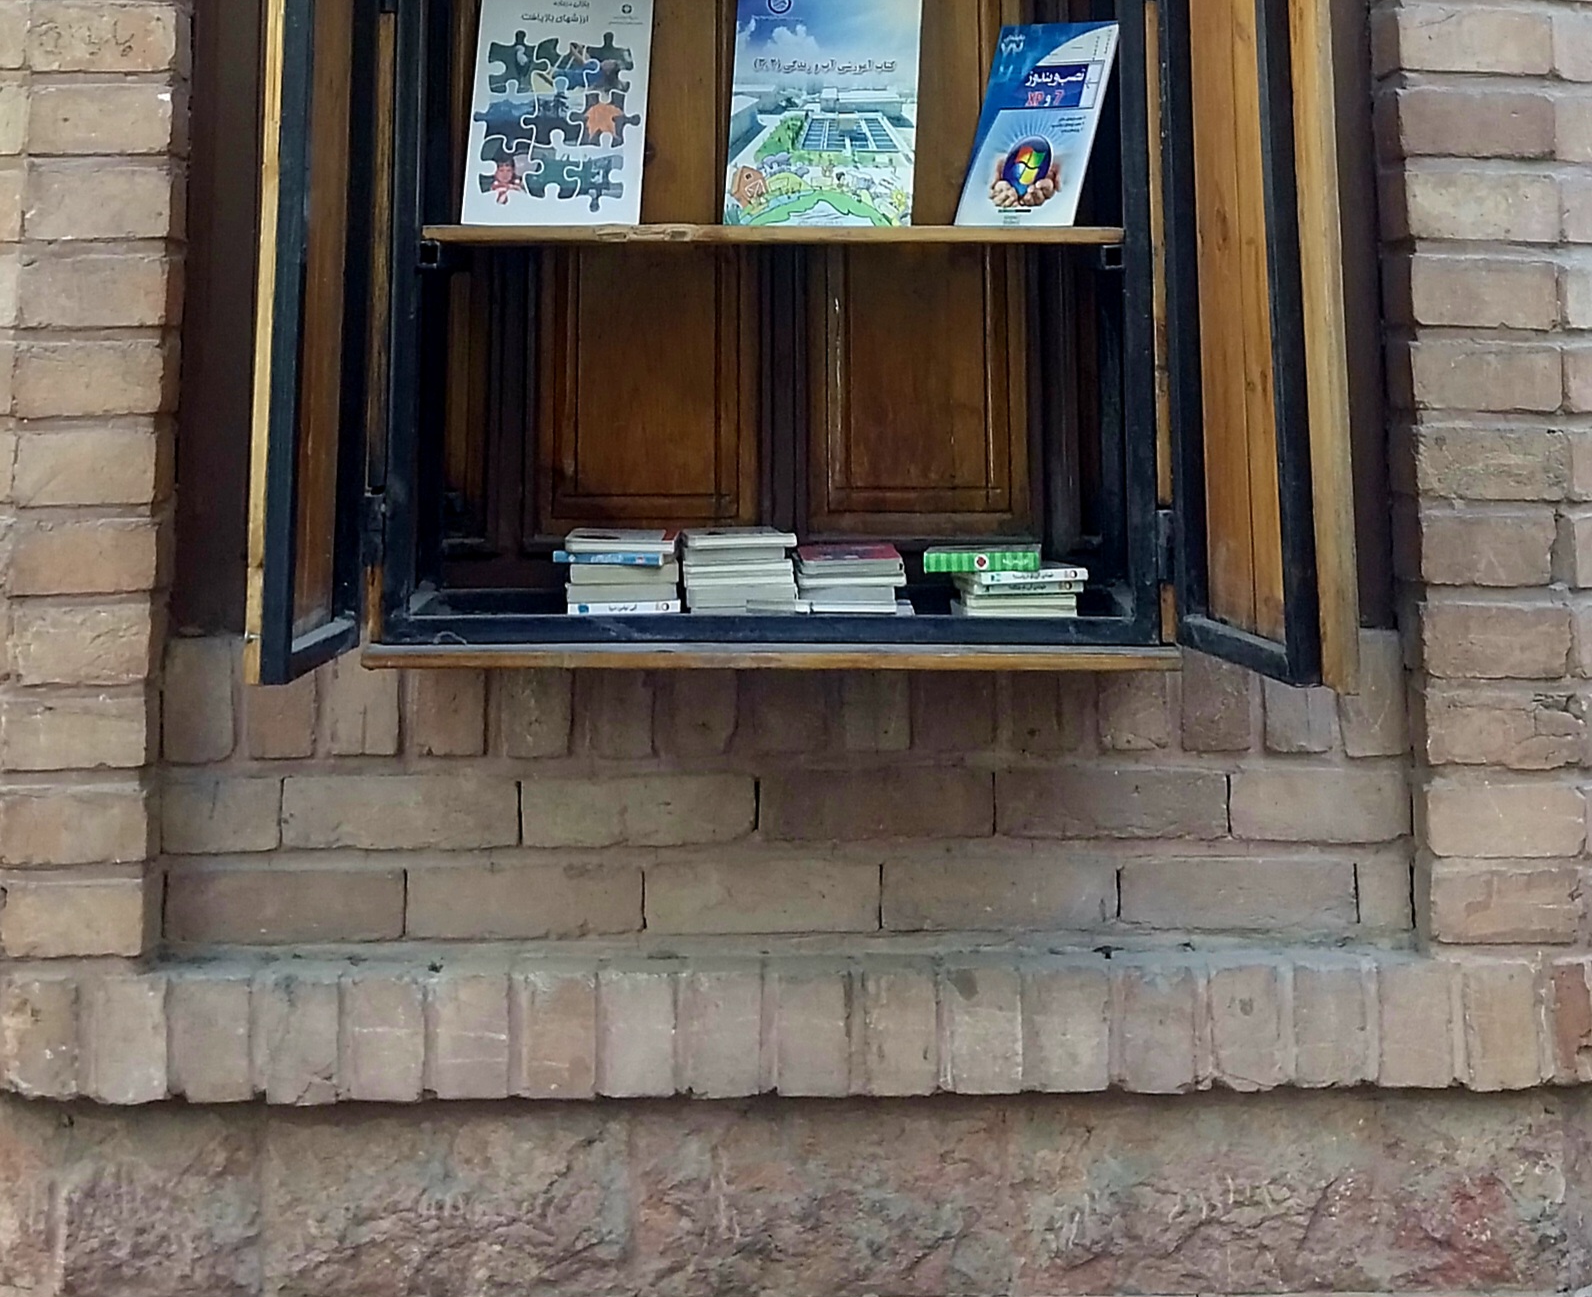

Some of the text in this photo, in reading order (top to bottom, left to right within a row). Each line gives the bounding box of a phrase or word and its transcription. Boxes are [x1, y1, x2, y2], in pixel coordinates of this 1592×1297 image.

[783, 60, 811, 73] زندگی
[821, 59, 834, 71] آب
[837, 59, 871, 72] آموزشی
[875, 60, 895, 71] کتاب
[1025, 91, 1044, 106] XP
